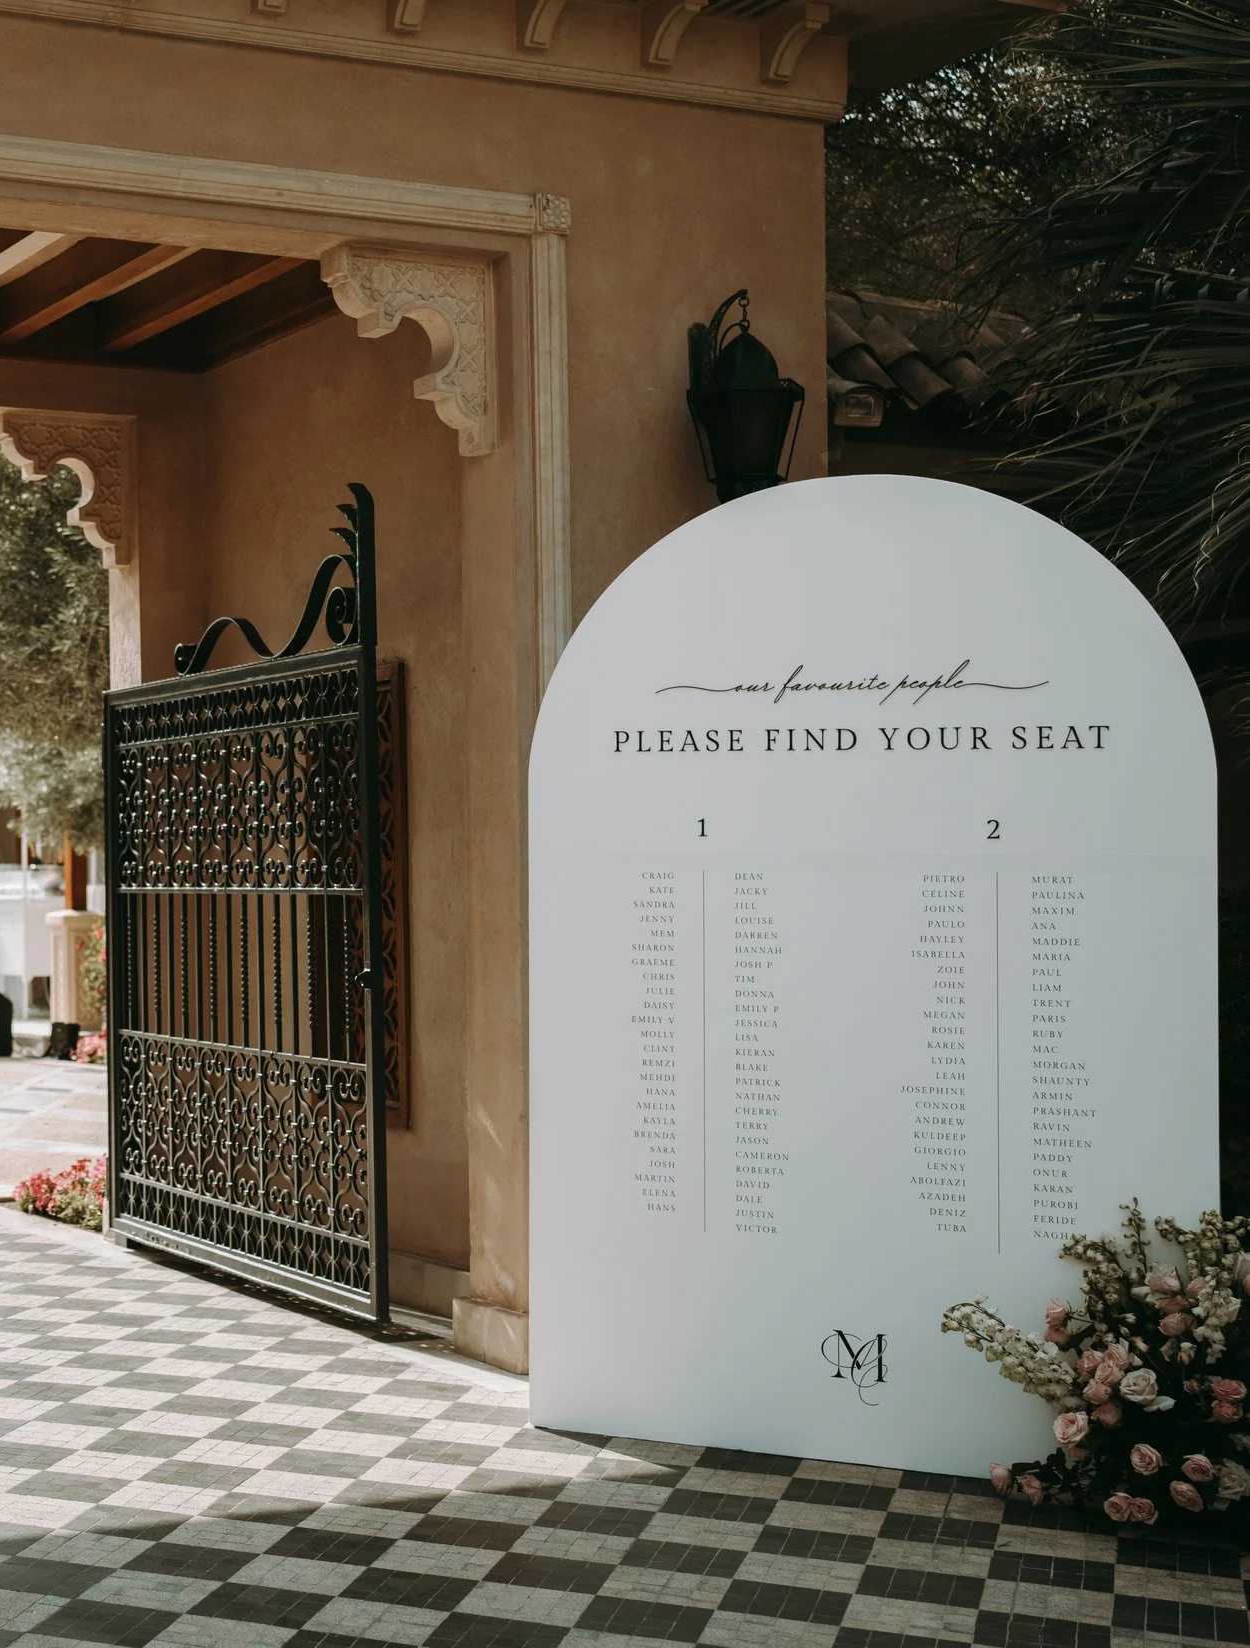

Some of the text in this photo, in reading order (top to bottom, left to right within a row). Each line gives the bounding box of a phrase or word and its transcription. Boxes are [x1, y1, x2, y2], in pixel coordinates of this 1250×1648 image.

[773, 664, 890, 704] favourite
[614, 724, 1110, 753] PLEASE FIND YOUR SEAT
[696, 817, 708, 838] 1
[986, 819, 1001, 840] 2
[641, 871, 674, 880] CRAIG
[734, 872, 764, 881] DEAN
[923, 874, 965, 883] PIETRO
[1031, 875, 1074, 885] MURAT
[649, 886, 675, 895] KATE
[733, 887, 768, 896] JACKY
[1031, 891, 1085, 900] PAULINA
[632, 900, 675, 909] SANDRA
[734, 901, 757, 910] JILL
[922, 904, 964, 913] JOHNN
[1032, 906, 1075, 916] MAXIM
[639, 914, 675, 924] JENNY
[734, 916, 774, 925] LOUISE
[927, 920, 965, 929] PAULO
[1031, 922, 1056, 931] ANA
[650, 929, 675, 938] MEM
[734, 931, 778, 940] DARREN
[919, 935, 965, 944] HAYLEY
[1032, 937, 1081, 947] MADDIE
[631, 943, 675, 952] SHARON
[734, 945, 782, 955] HANNAH
[911, 949, 966, 959] ISABELLA
[1032, 952, 1071, 962] MARIA
[631, 958, 675, 967] GRAEME
[734, 960, 762, 969] JOSH
[937, 965, 965, 975] ZOIE
[1032, 968, 1062, 977] PAUL
[642, 972, 675, 981] CHRIS
[734, 975, 755, 983] TIM
[932, 980, 965, 990] JOHN
[1032, 983, 1062, 993] LIAM
[645, 986, 675, 996] JULIE
[735, 989, 775, 999] DONNA
[643, 1000, 675, 1010] DAISY
[936, 995, 966, 1005] NICK
[1031, 998, 1071, 1008] TRENT
[735, 1004, 767, 1014] EMILY
[631, 1015, 662, 1024] EMILY
[923, 1010, 965, 1021] MEGAN
[1032, 1013, 1066, 1024] PARIS
[734, 1018, 778, 1028] JESSICA
[640, 1029, 675, 1039] MOLLY
[931, 1025, 966, 1035] ROSIE
[1032, 1029, 1063, 1039] RUBY
[735, 1033, 759, 1043] LISA
[643, 1044, 676, 1053] CLINT
[927, 1040, 965, 1050] KAREN
[1032, 1045, 1059, 1054] MAC
[735, 1048, 775, 1057] KIERAN
[642, 1058, 675, 1068] REMZI
[931, 1056, 966, 1066] LYDIA
[1032, 1060, 1086, 1071] MORGAN
[735, 1062, 769, 1072] BLAKE
[639, 1073, 675, 1083] MEHDI
[935, 1071, 965, 1081] LEAH
[1032, 1075, 1091, 1087] SHAUNTY
[735, 1077, 781, 1087] PATRICK
[646, 1087, 676, 1097] HANA
[899, 1085, 966, 1096] JOSEPHINE
[1032, 1090, 1073, 1101] ARMIN
[735, 1092, 780, 1102] NATHAN
[636, 1101, 676, 1111] AMELIA
[914, 1099, 966, 1111] CONNOR
[734, 1107, 778, 1117] CHERRY
[1033, 1106, 1097, 1118] PRASHANT
[643, 1116, 676, 1126] KAYLA
[914, 1115, 966, 1126] ANDREW
[734, 1121, 768, 1131] TERRY
[1033, 1121, 1070, 1132] RAVIN
[634, 1130, 676, 1140] BRENDA
[735, 1135, 769, 1145] JASON
[913, 1130, 967, 1142] KULDEEP
[1033, 1137, 1092, 1149] MATHEEN
[649, 1145, 676, 1155] SARA
[913, 1145, 967, 1157] GIORGIO
[735, 1150, 789, 1161] CAMERON
[1033, 1152, 1073, 1163] PADDY
[648, 1159, 675, 1169] JOSH
[926, 1161, 966, 1172] LENNY
[735, 1165, 784, 1176] ROBERTA
[1032, 1168, 1068, 1179] ONUR
[634, 1173, 675, 1184] MARTIN
[735, 1179, 770, 1190] DAVID
[1033, 1183, 1073, 1194] KARAN
[642, 1188, 676, 1198] ELENA
[918, 1191, 966, 1203] AZADEH
[735, 1194, 763, 1204] DALE
[647, 1203, 676, 1213] HANS
[1033, 1199, 1079, 1210] PUROBI
[735, 1208, 774, 1219] JUSTIN
[929, 1207, 967, 1218] DENIZ
[1033, 1214, 1076, 1226] FERIDE
[735, 1223, 778, 1235] VICTOR
[936, 1223, 967, 1233] TUBA
